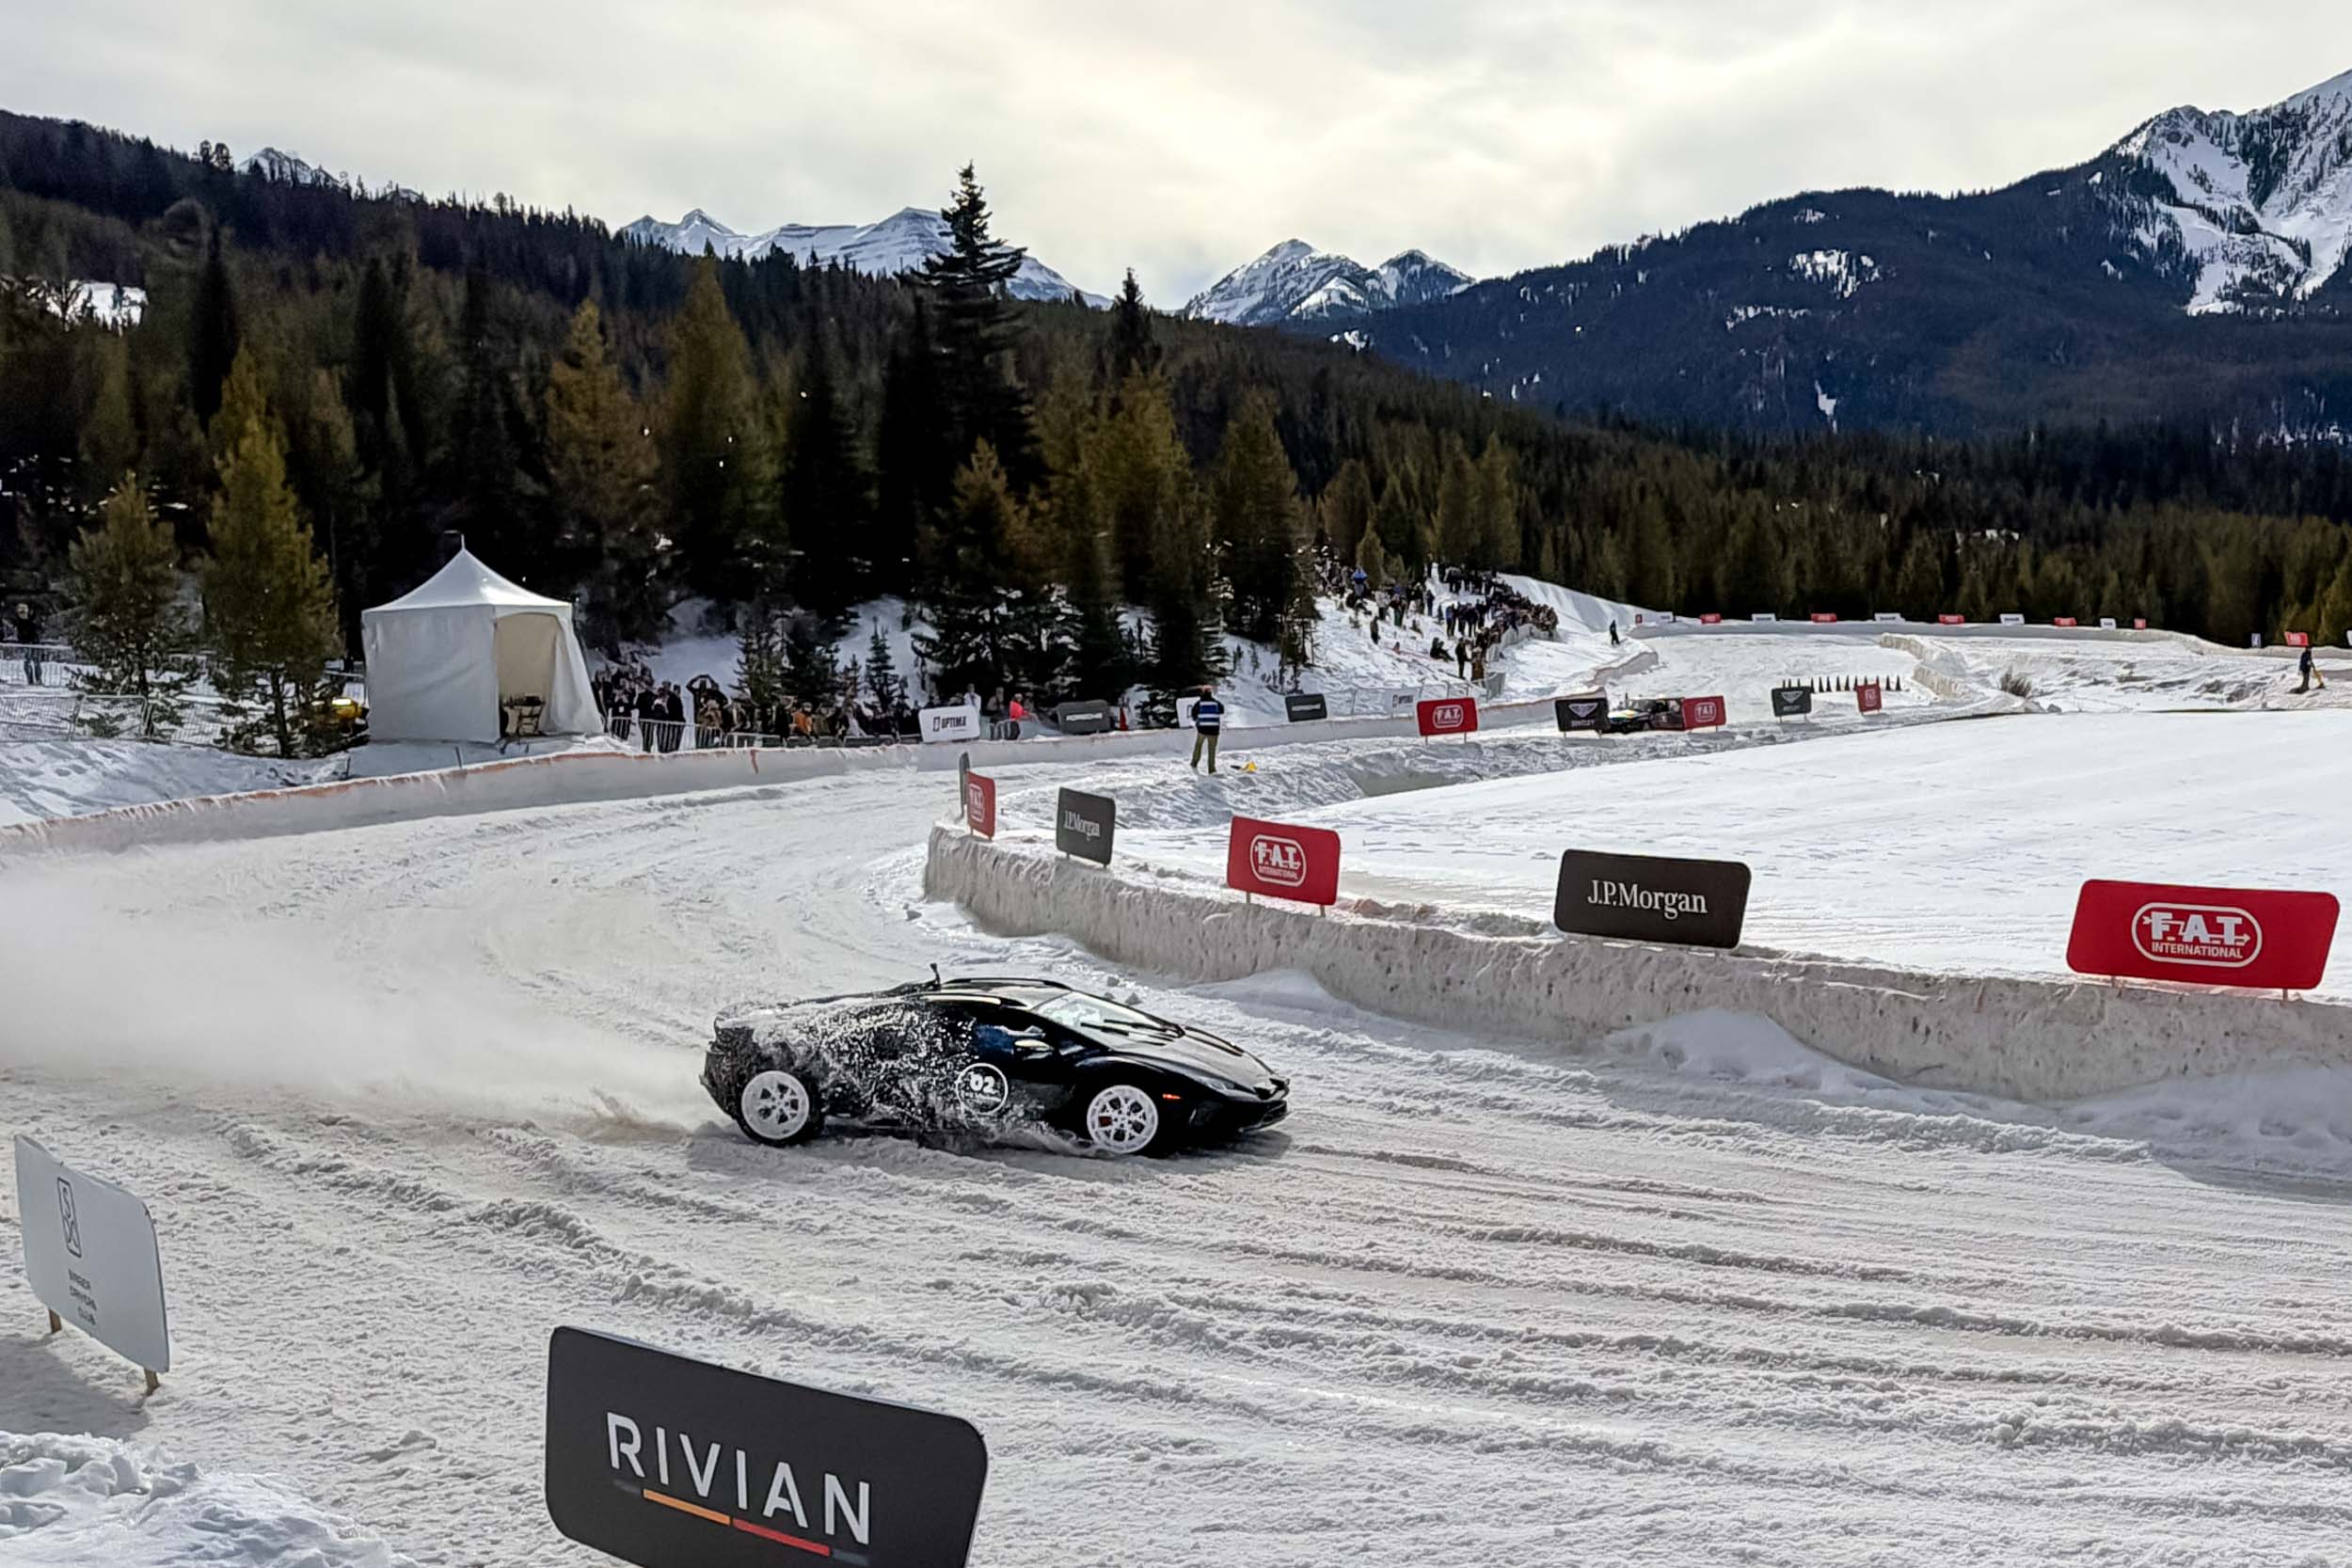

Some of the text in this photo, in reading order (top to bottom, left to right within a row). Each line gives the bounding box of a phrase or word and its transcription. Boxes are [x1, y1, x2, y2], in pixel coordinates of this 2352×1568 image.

[942, 716, 966, 729] OPTIMA
[1587, 879, 1708, 920] J.P.Morgan
[2151, 941, 2244, 958] INTERNATIONAL
[969, 1072, 999, 1095] 02
[605, 1411, 871, 1545] RIVIAN
